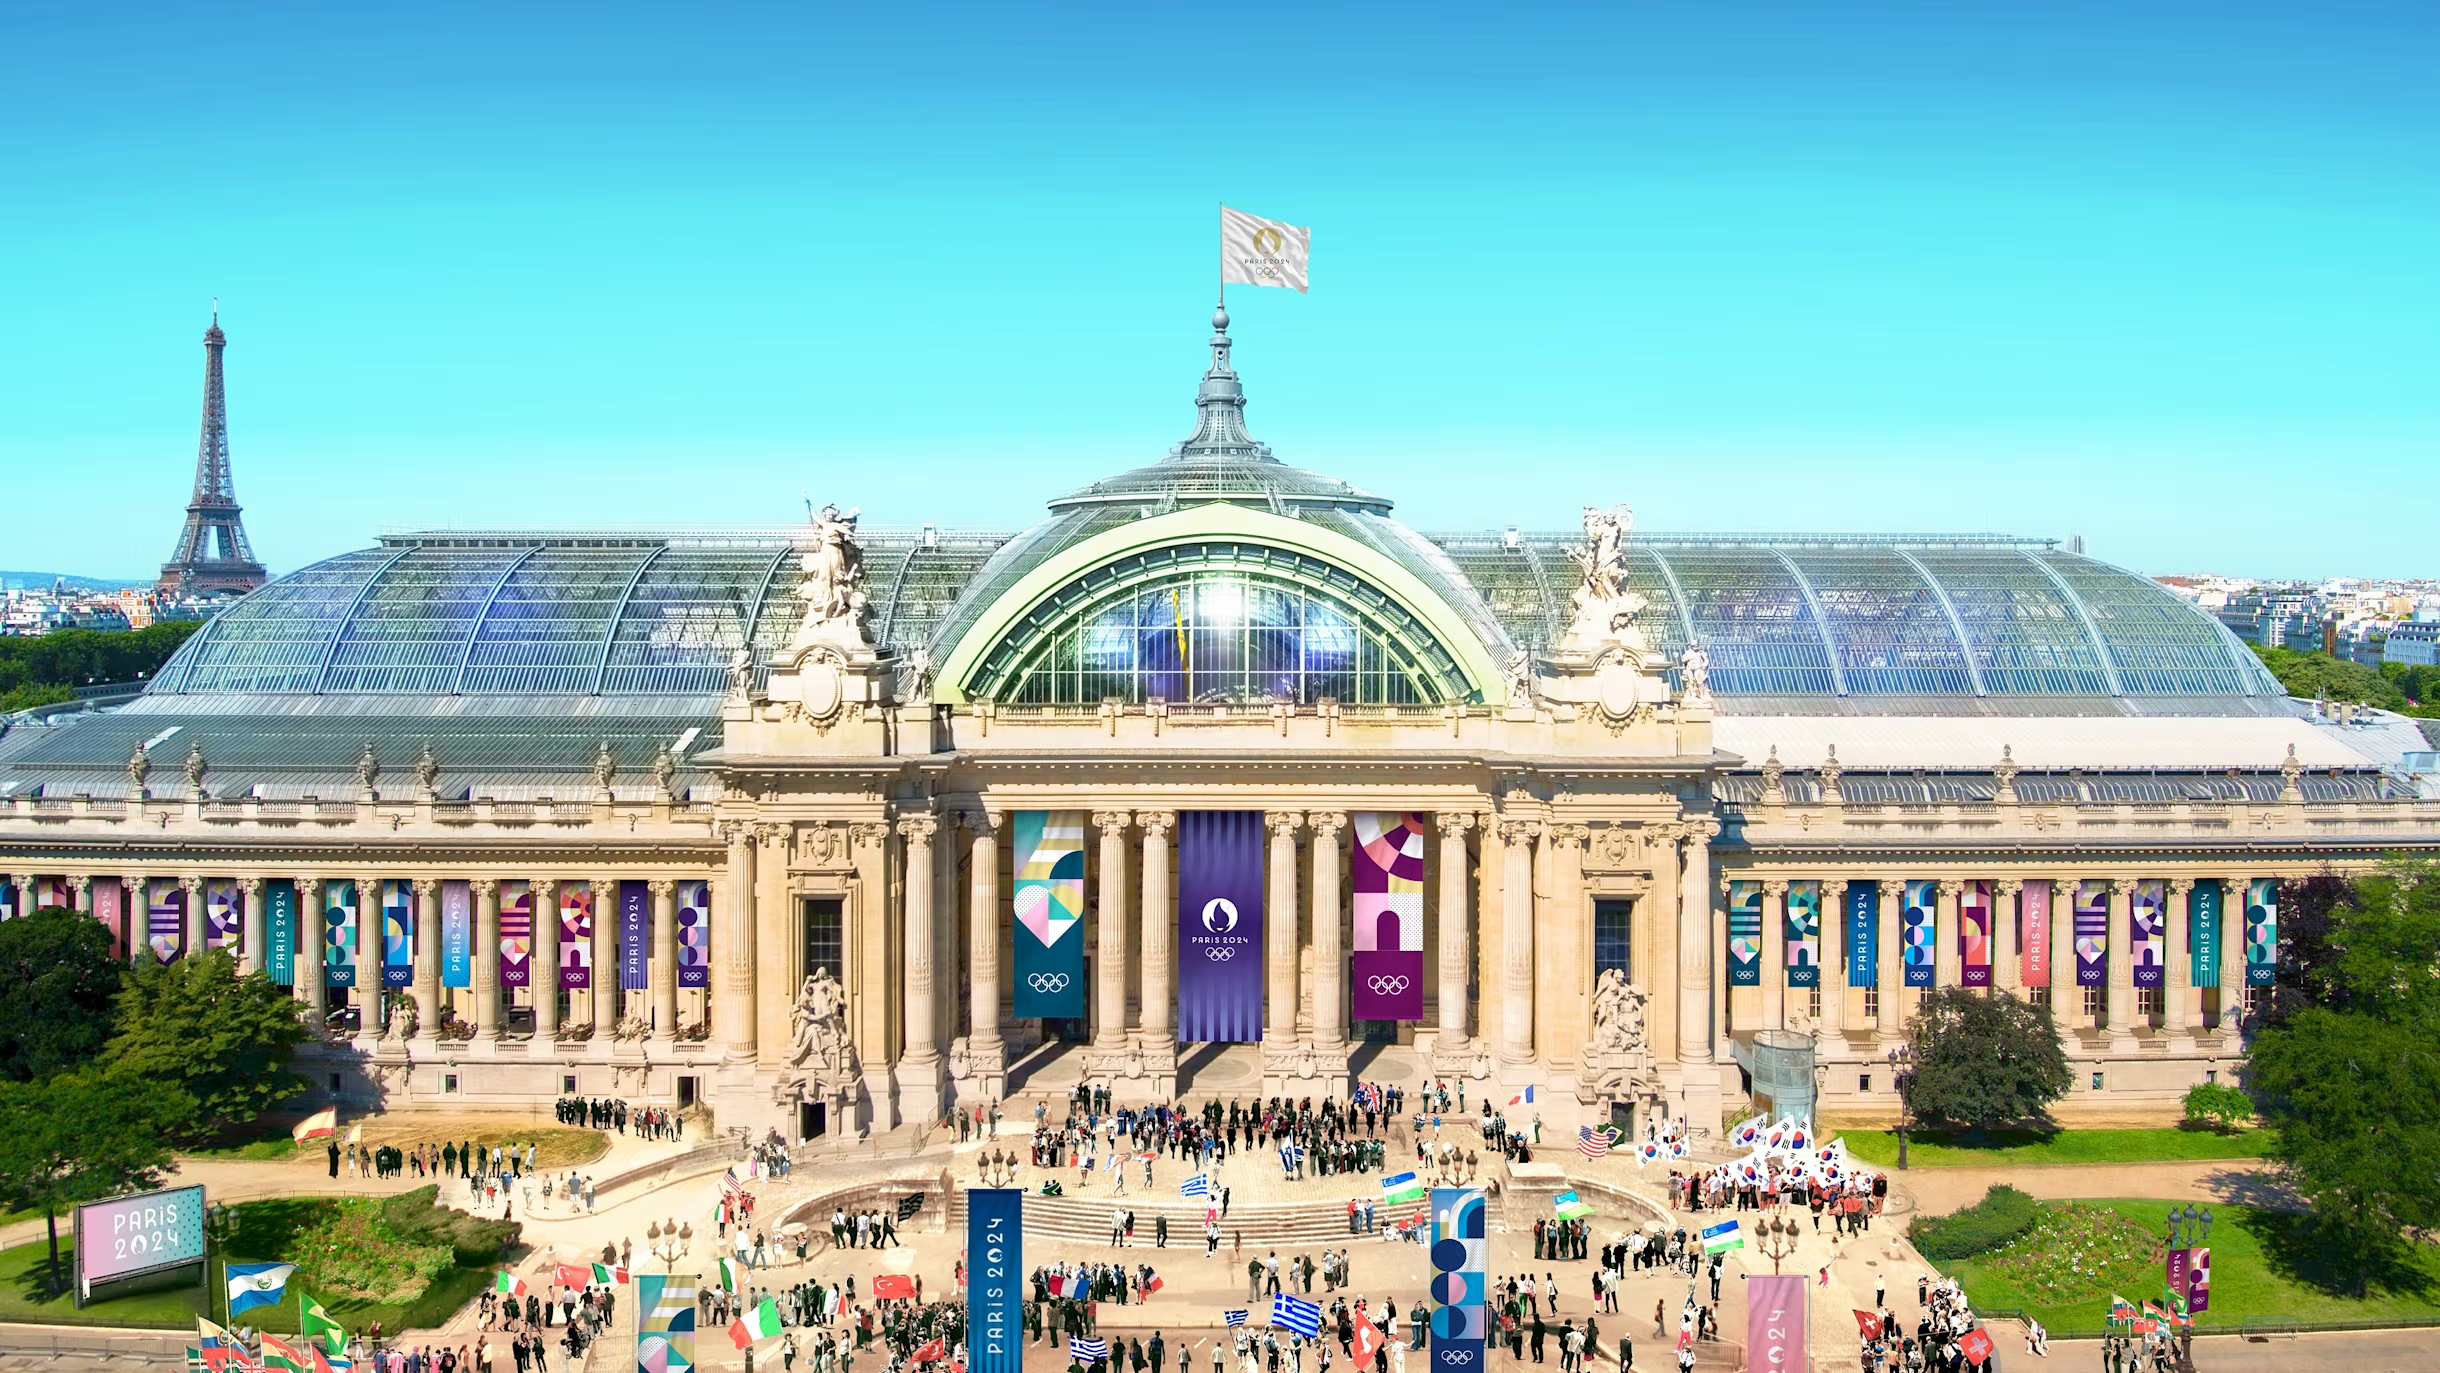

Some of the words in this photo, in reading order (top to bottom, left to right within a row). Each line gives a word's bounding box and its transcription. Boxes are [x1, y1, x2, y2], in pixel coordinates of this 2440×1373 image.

[276, 892, 285, 926] 2024
[452, 894, 461, 928] 2024
[629, 896, 638, 930] 2024
[1858, 894, 1867, 927] 2024
[2032, 894, 2040, 928] 2024
[2201, 894, 2210, 928] 2024
[1223, 936, 1248, 944] 2024
[114, 1229, 178, 1260] 2024
[987, 1218, 1004, 1278] 2024
[2173, 1254, 2181, 1278] 2024
